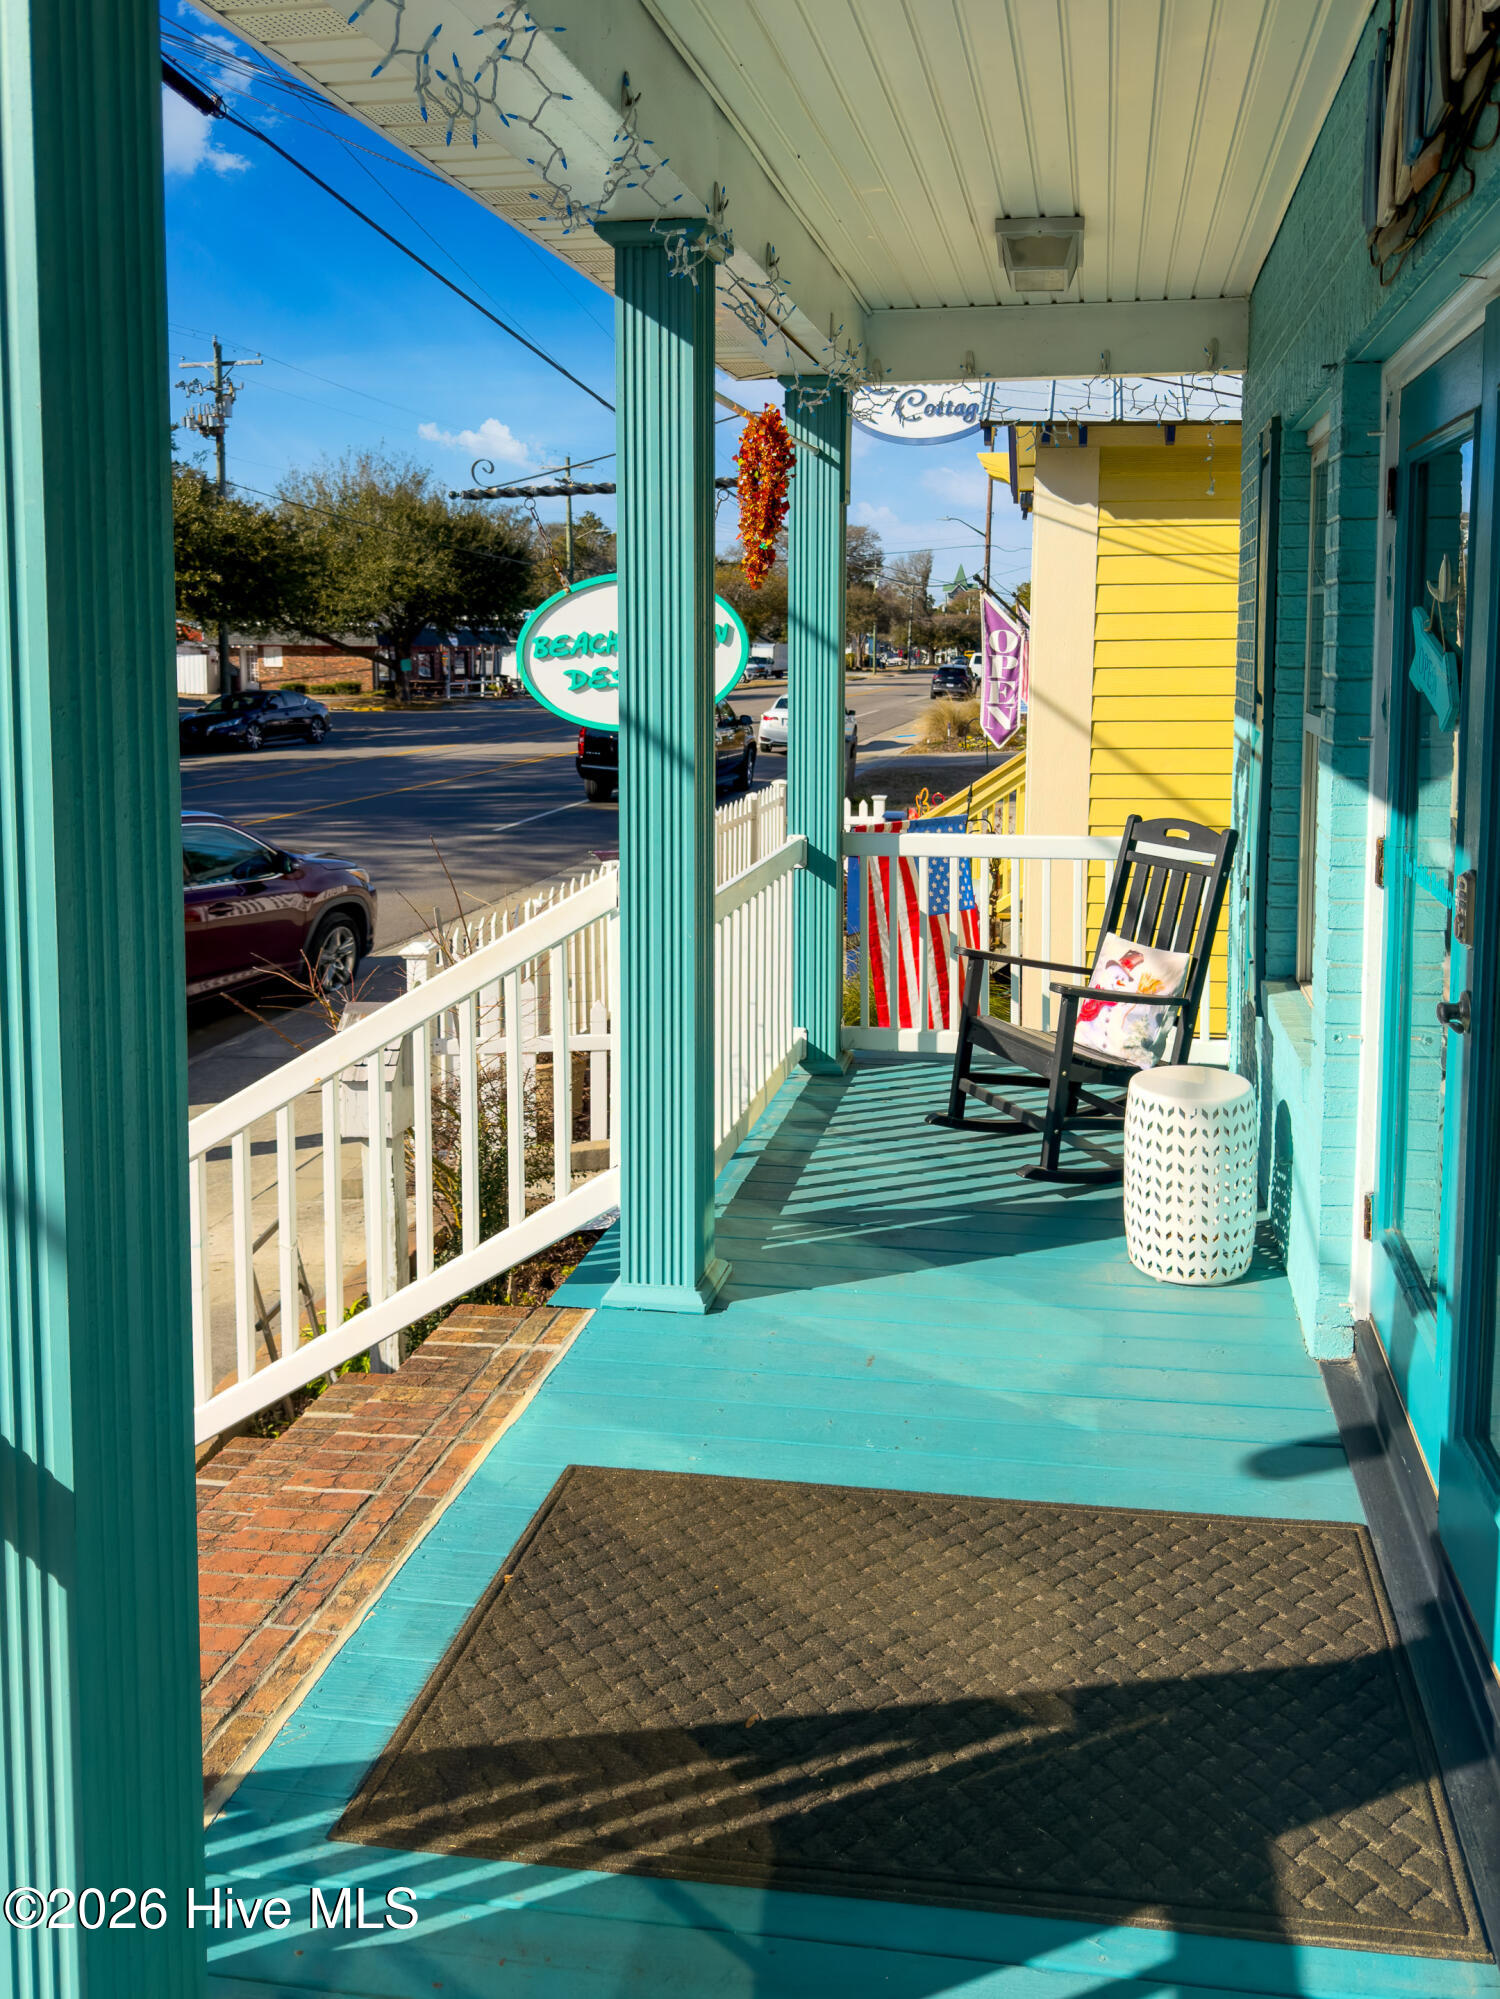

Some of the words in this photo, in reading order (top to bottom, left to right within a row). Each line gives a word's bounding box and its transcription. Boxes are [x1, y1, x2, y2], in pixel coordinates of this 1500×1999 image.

[895, 389, 980, 424] Cottag
[532, 630, 619, 659] BEACH
[563, 666, 619, 691] DES
[987, 629, 1019, 731] OPEN
